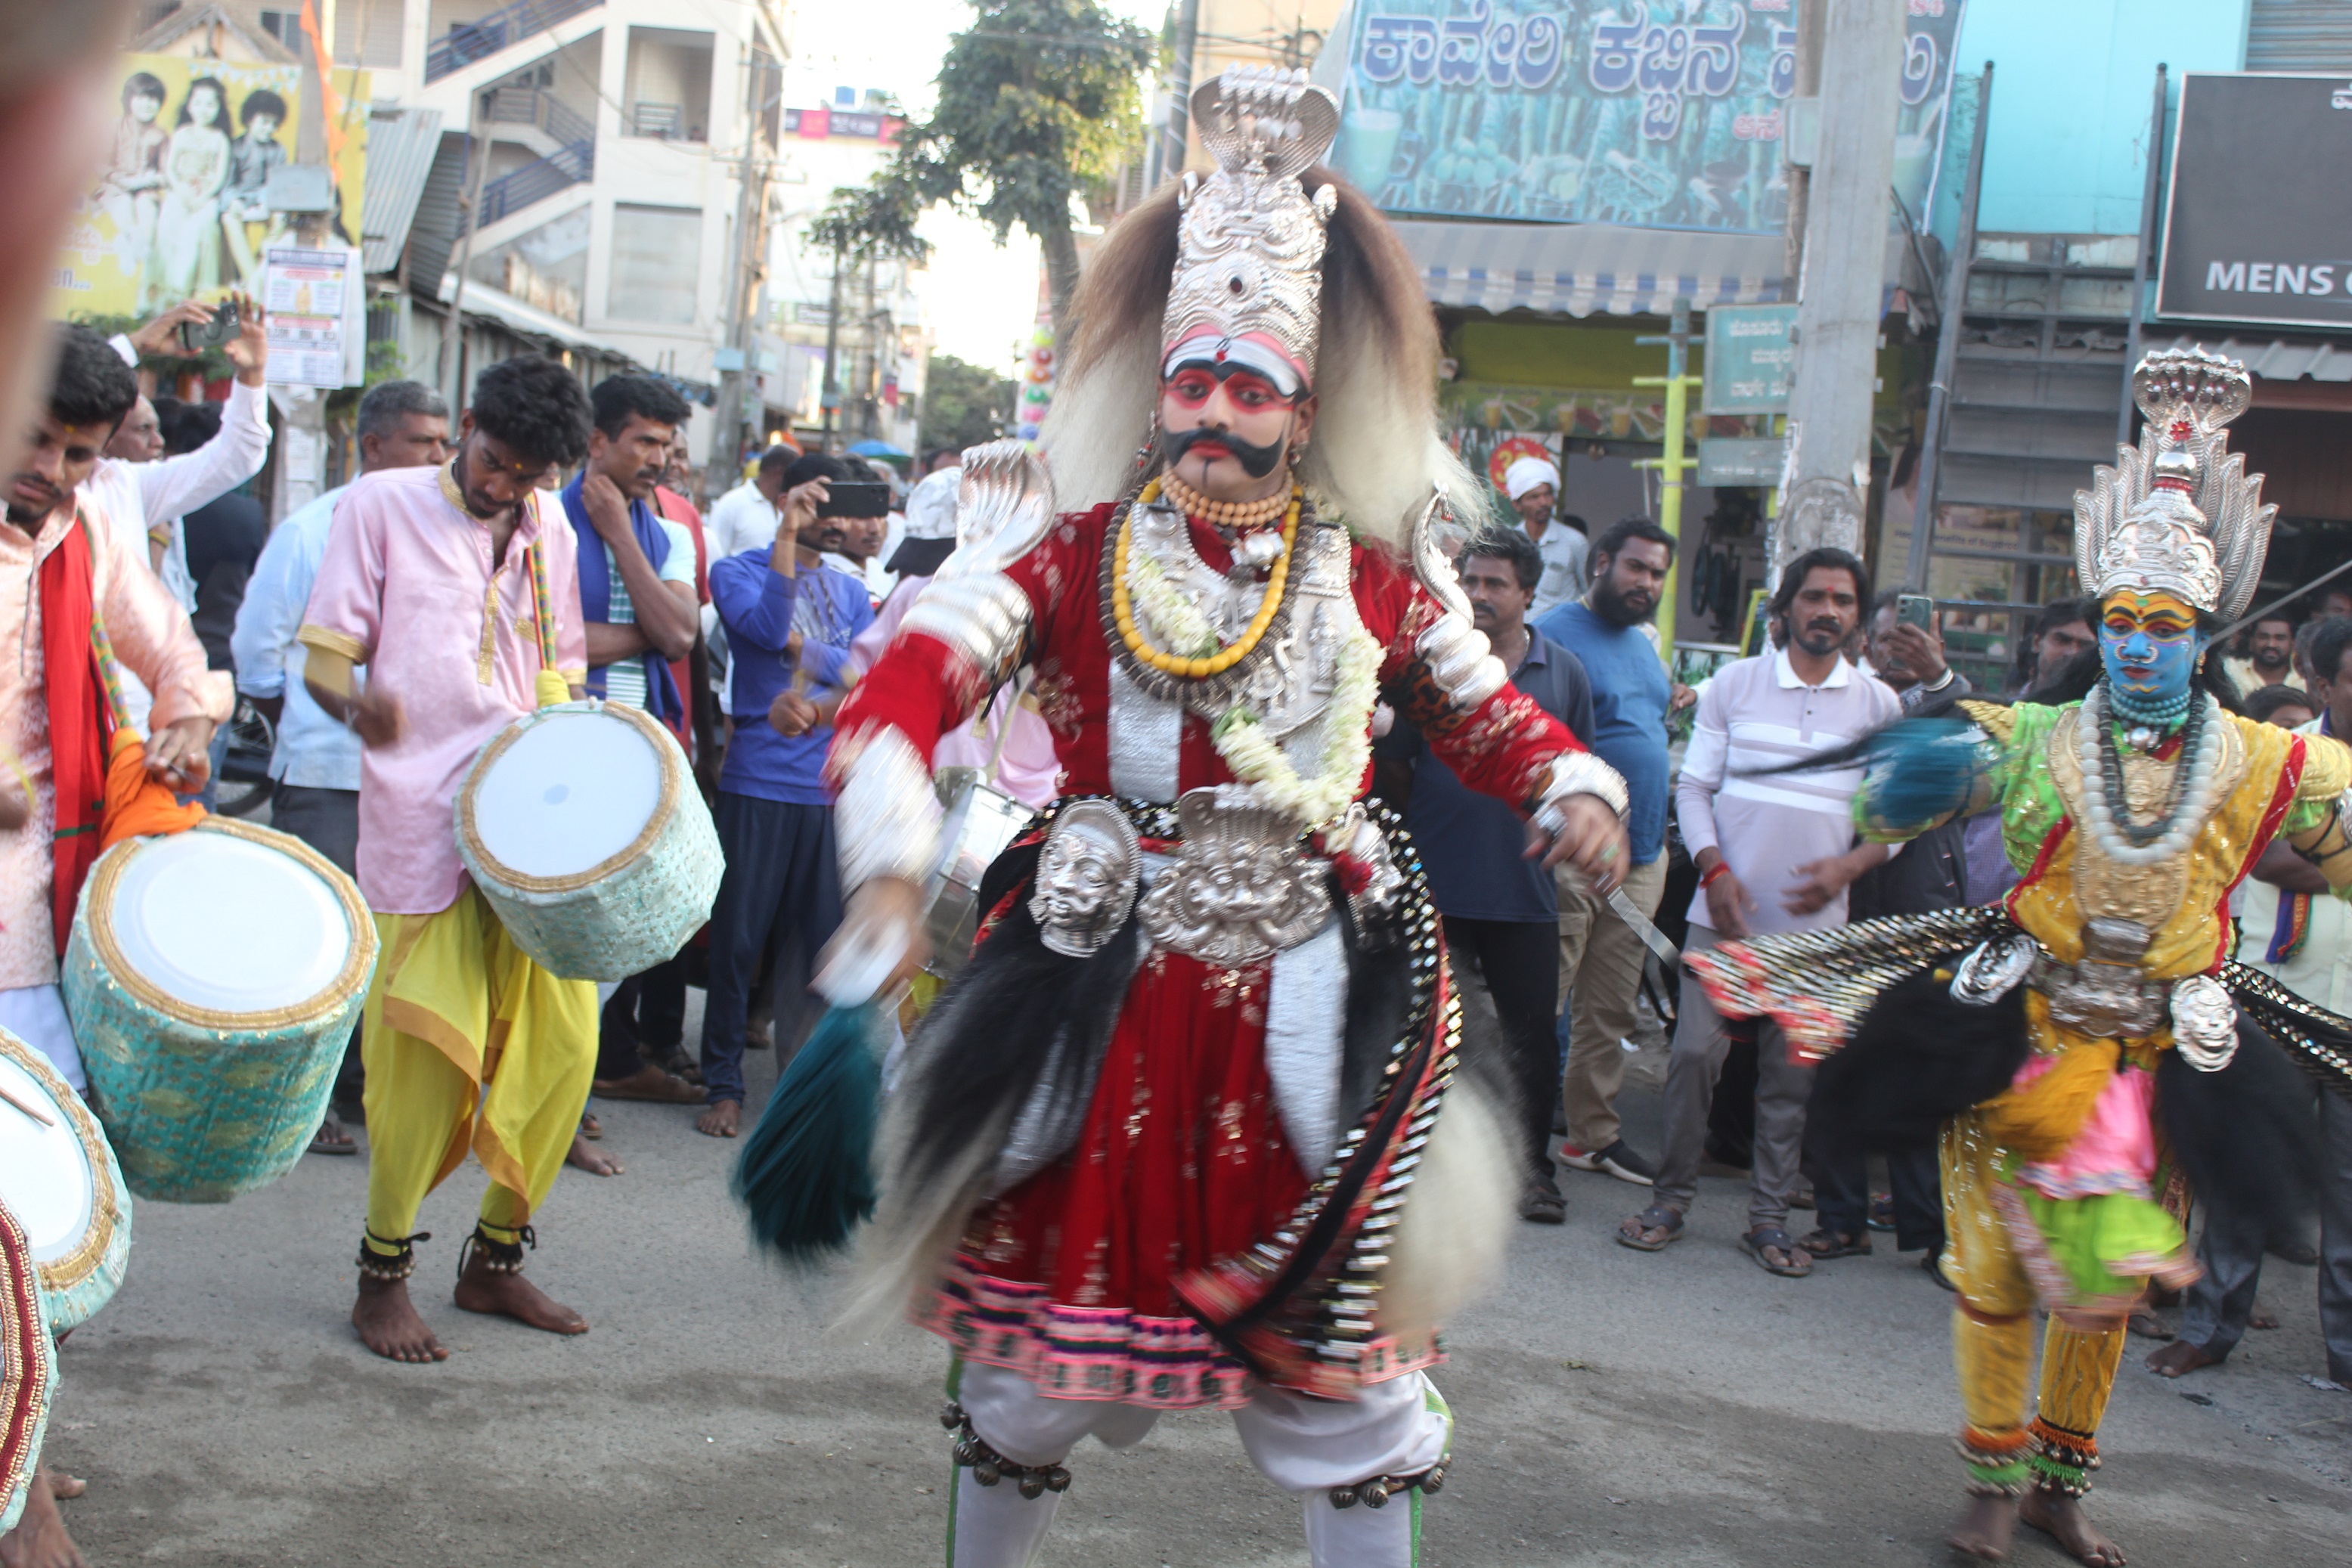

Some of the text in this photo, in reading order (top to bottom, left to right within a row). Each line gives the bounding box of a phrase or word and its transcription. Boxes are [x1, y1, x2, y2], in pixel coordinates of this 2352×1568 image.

[1362, 0, 1563, 88] ಕಾವೇರಿ
[1589, 2, 1746, 140] ಕಬ್ಬಿನ
[2205, 261, 2335, 296] MENS
